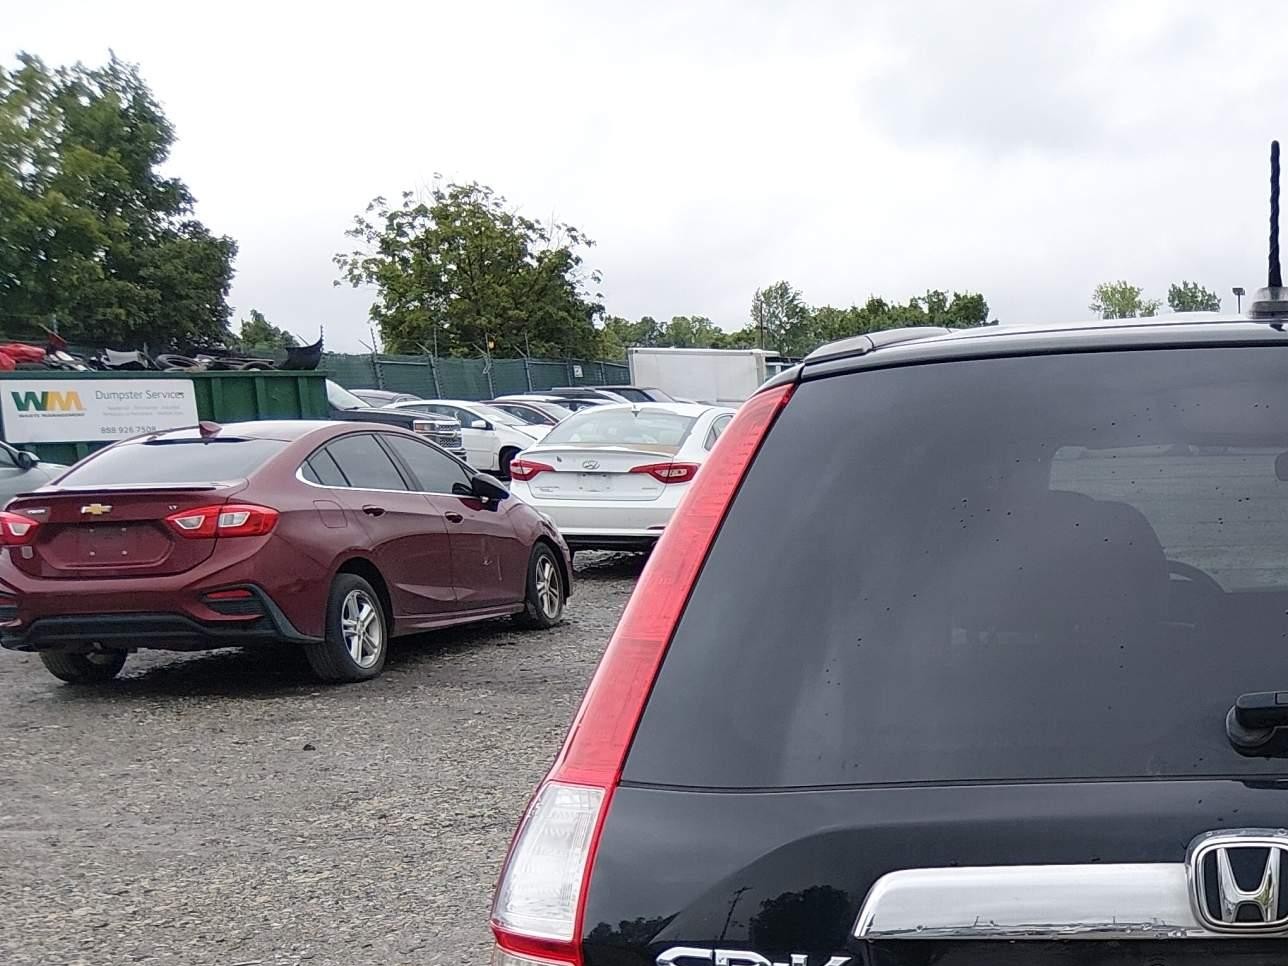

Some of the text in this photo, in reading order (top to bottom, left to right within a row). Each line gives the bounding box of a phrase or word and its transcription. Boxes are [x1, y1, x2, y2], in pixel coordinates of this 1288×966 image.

[11, 391, 85, 411] WM
[95, 389, 185, 401] Dumpster Services
